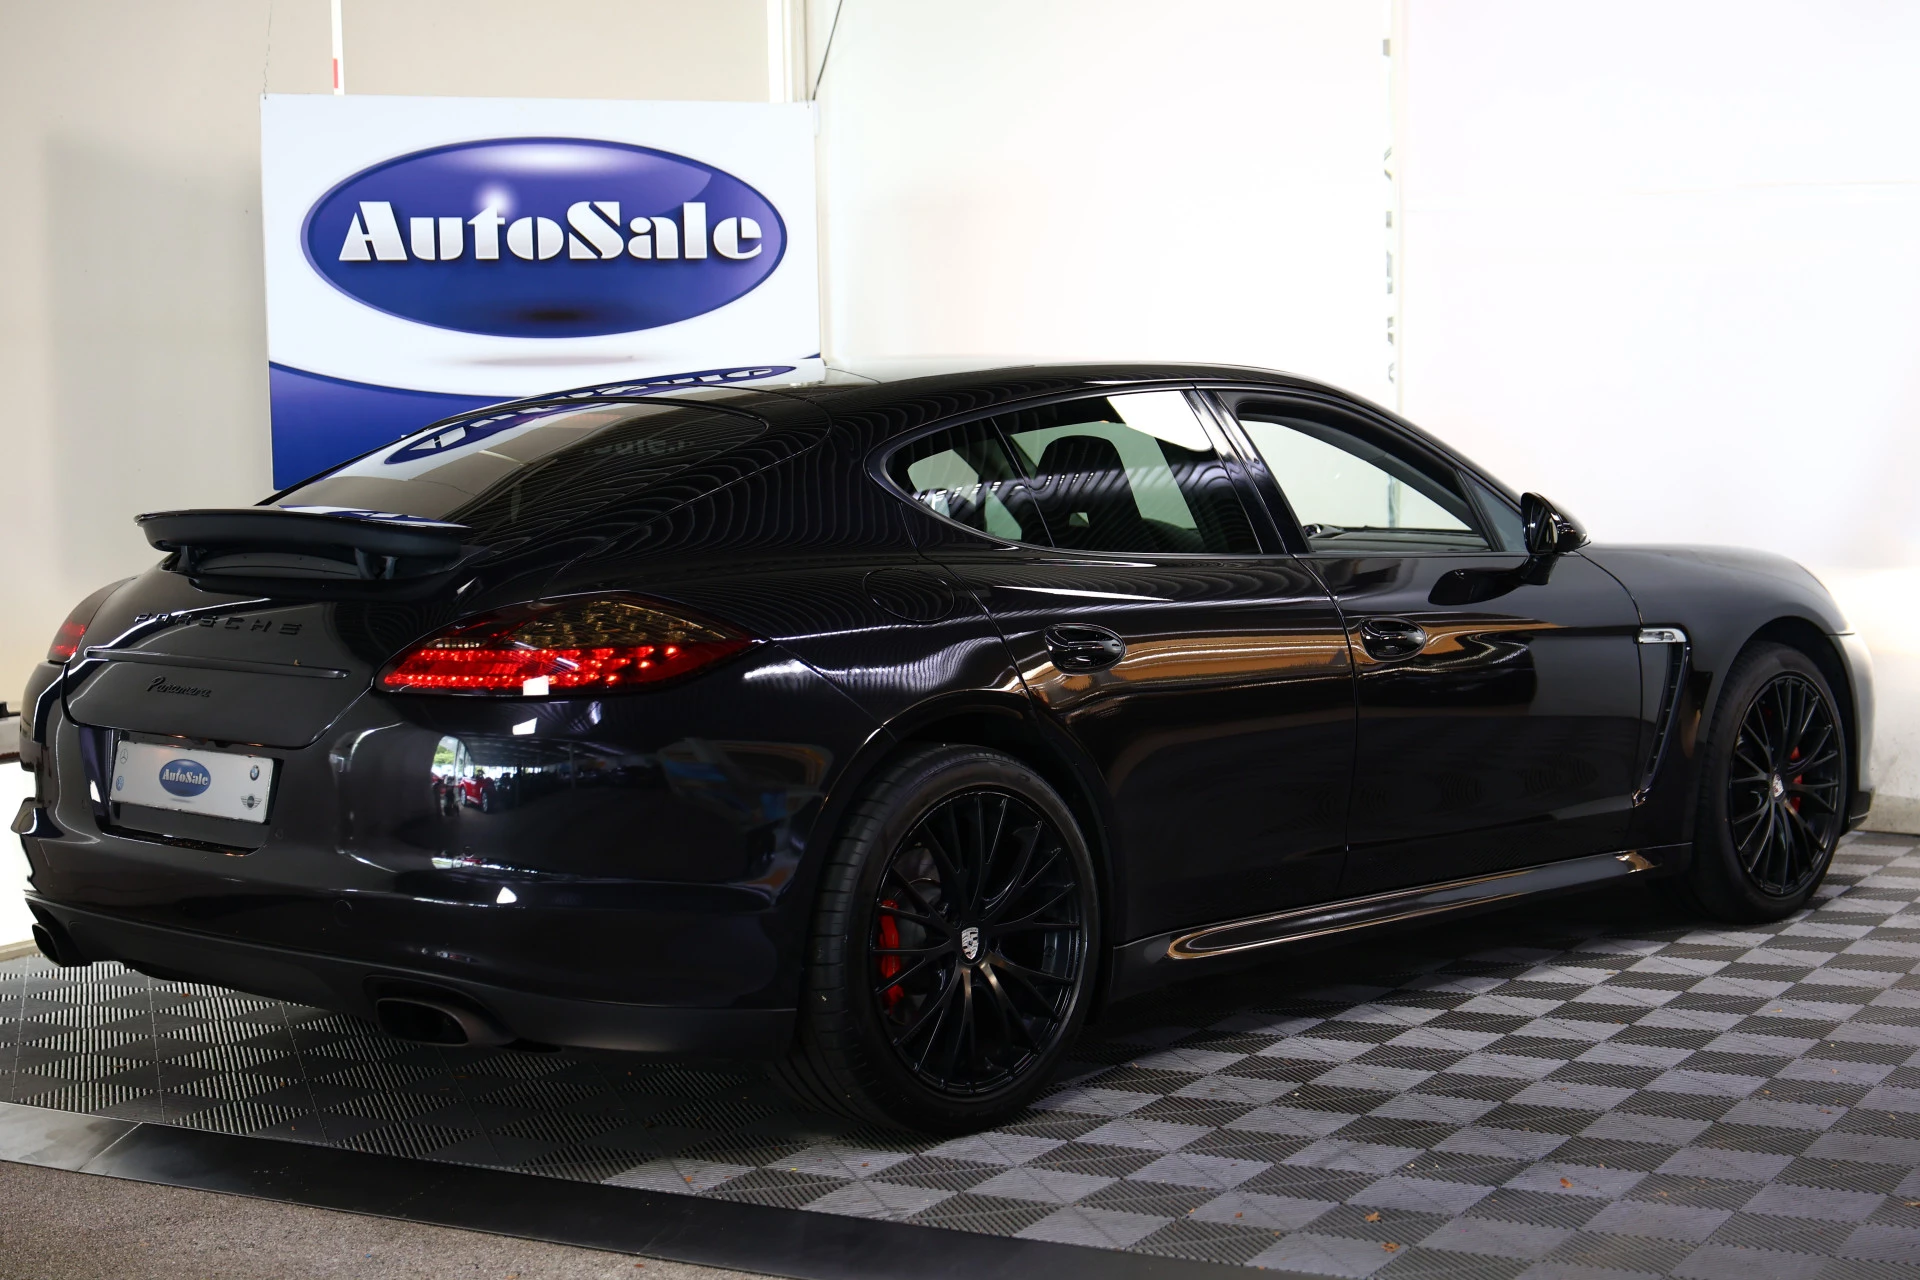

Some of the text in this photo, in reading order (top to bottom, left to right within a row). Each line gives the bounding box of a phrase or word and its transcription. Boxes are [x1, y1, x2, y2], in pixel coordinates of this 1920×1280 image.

[339, 201, 762, 261] AutoSale
[147, 675, 213, 698] Panamera
[162, 768, 208, 786] AutoSale
